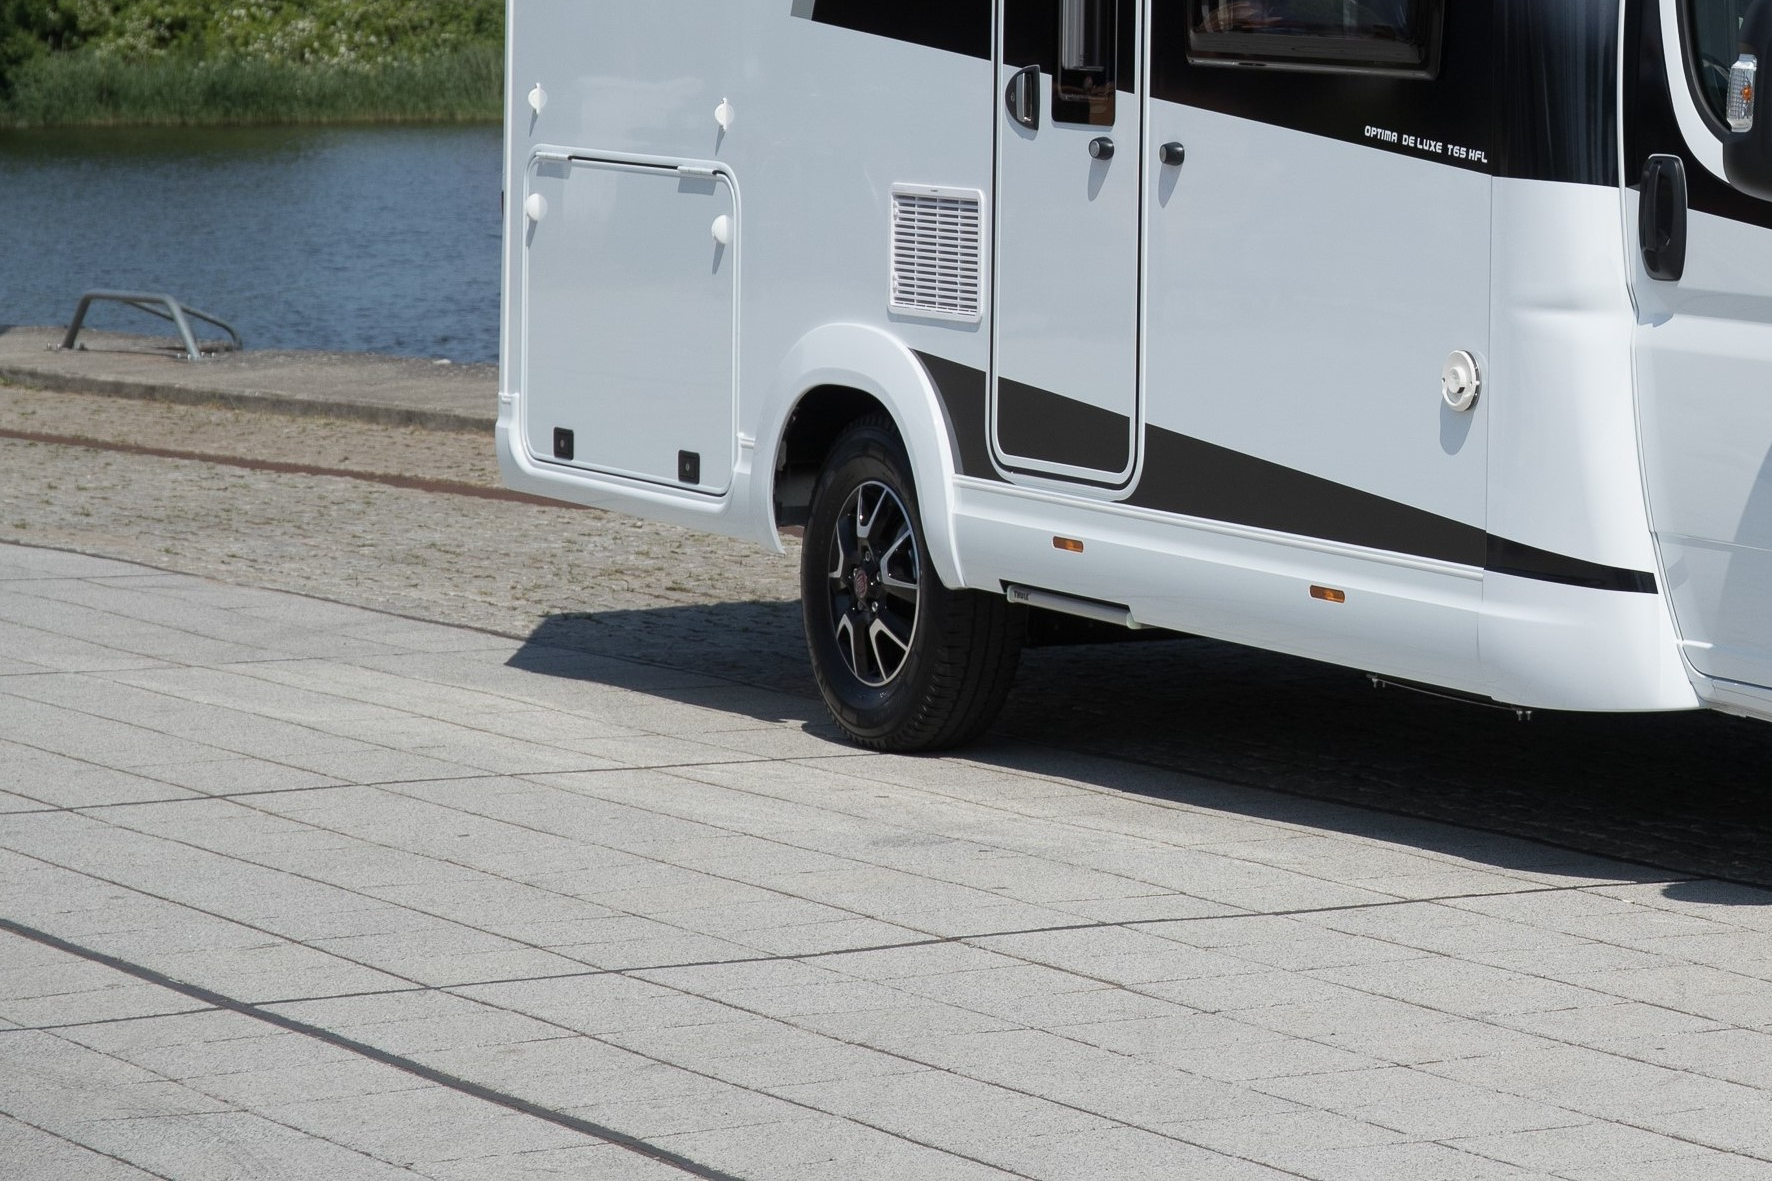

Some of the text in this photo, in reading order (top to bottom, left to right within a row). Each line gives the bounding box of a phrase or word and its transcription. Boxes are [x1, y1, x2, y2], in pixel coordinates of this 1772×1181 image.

[1364, 125, 1488, 163] OPTIMA DE LUXE T65 HFL
